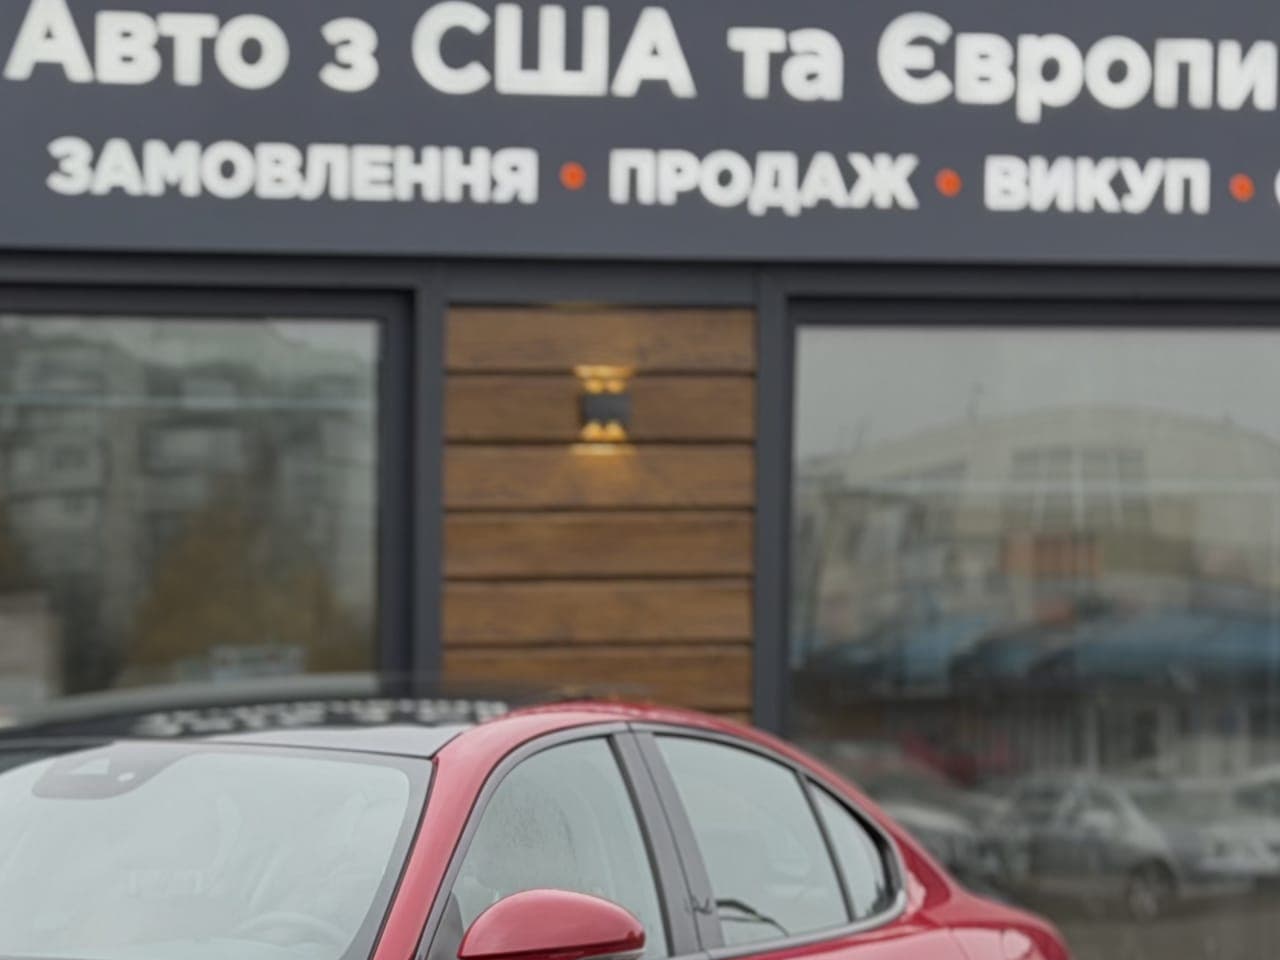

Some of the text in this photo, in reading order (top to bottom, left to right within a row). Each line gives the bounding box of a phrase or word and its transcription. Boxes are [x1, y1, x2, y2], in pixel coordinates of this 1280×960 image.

[3, 0, 1279, 124] Авто з США та Європи
[45, 136, 539, 205] ЗАМОВЛЕННЯ
[608, 148, 920, 217] ПРОДАЖ
[983, 154, 1211, 215] ВИКУП
